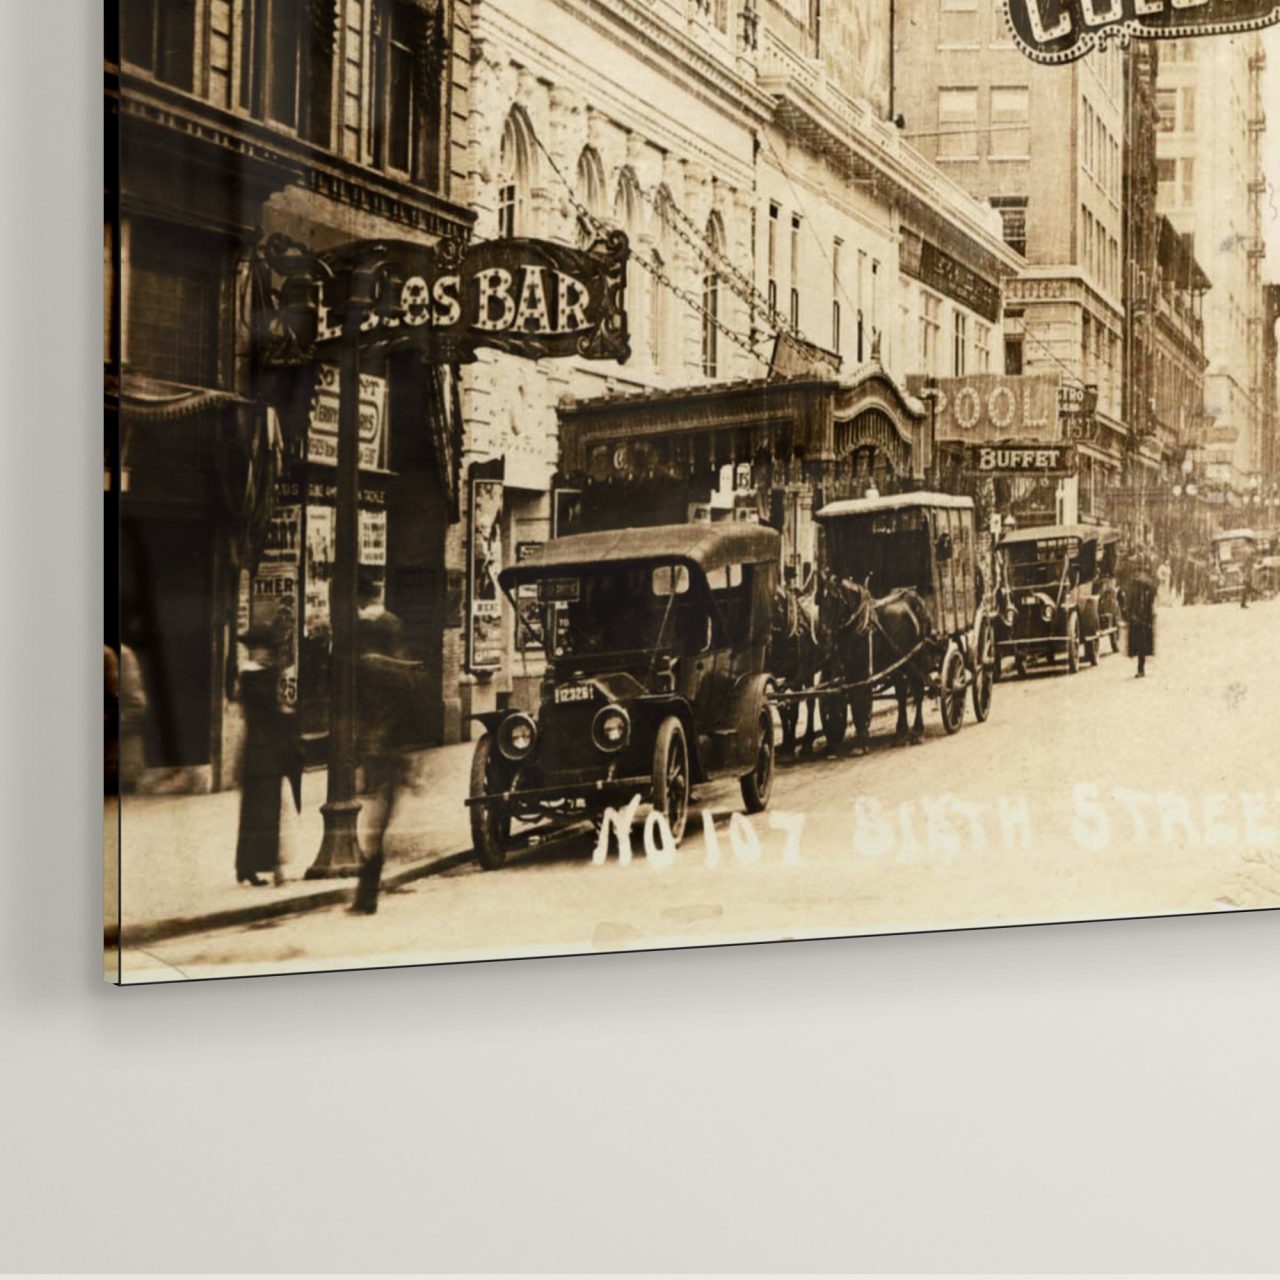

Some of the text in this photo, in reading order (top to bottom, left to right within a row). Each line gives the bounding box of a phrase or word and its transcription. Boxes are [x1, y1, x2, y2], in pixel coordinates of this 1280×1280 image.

[474, 264, 594, 334] BAR
[922, 385, 1048, 428] POOL
[979, 447, 1060, 470] BUFFET
